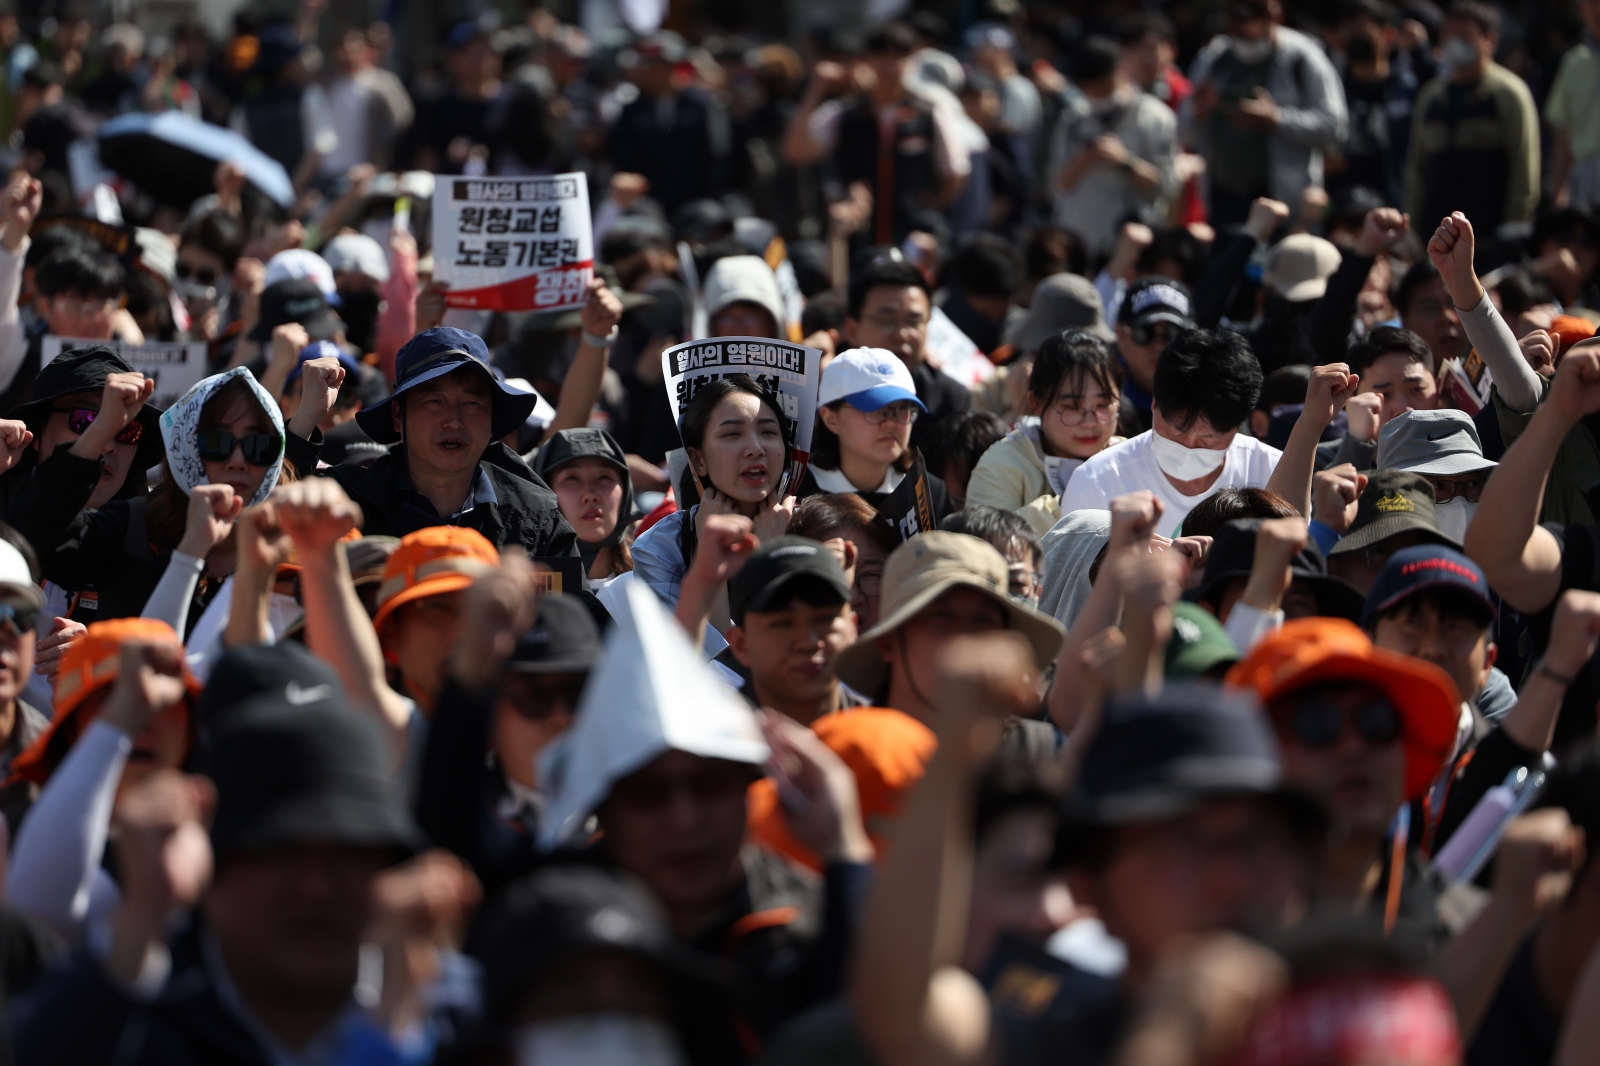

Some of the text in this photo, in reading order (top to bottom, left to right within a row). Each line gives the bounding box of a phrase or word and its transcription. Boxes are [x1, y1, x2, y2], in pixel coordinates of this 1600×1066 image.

[455, 239, 579, 267] 노동기본권
[676, 343, 800, 373] 열사의 염원이다!
